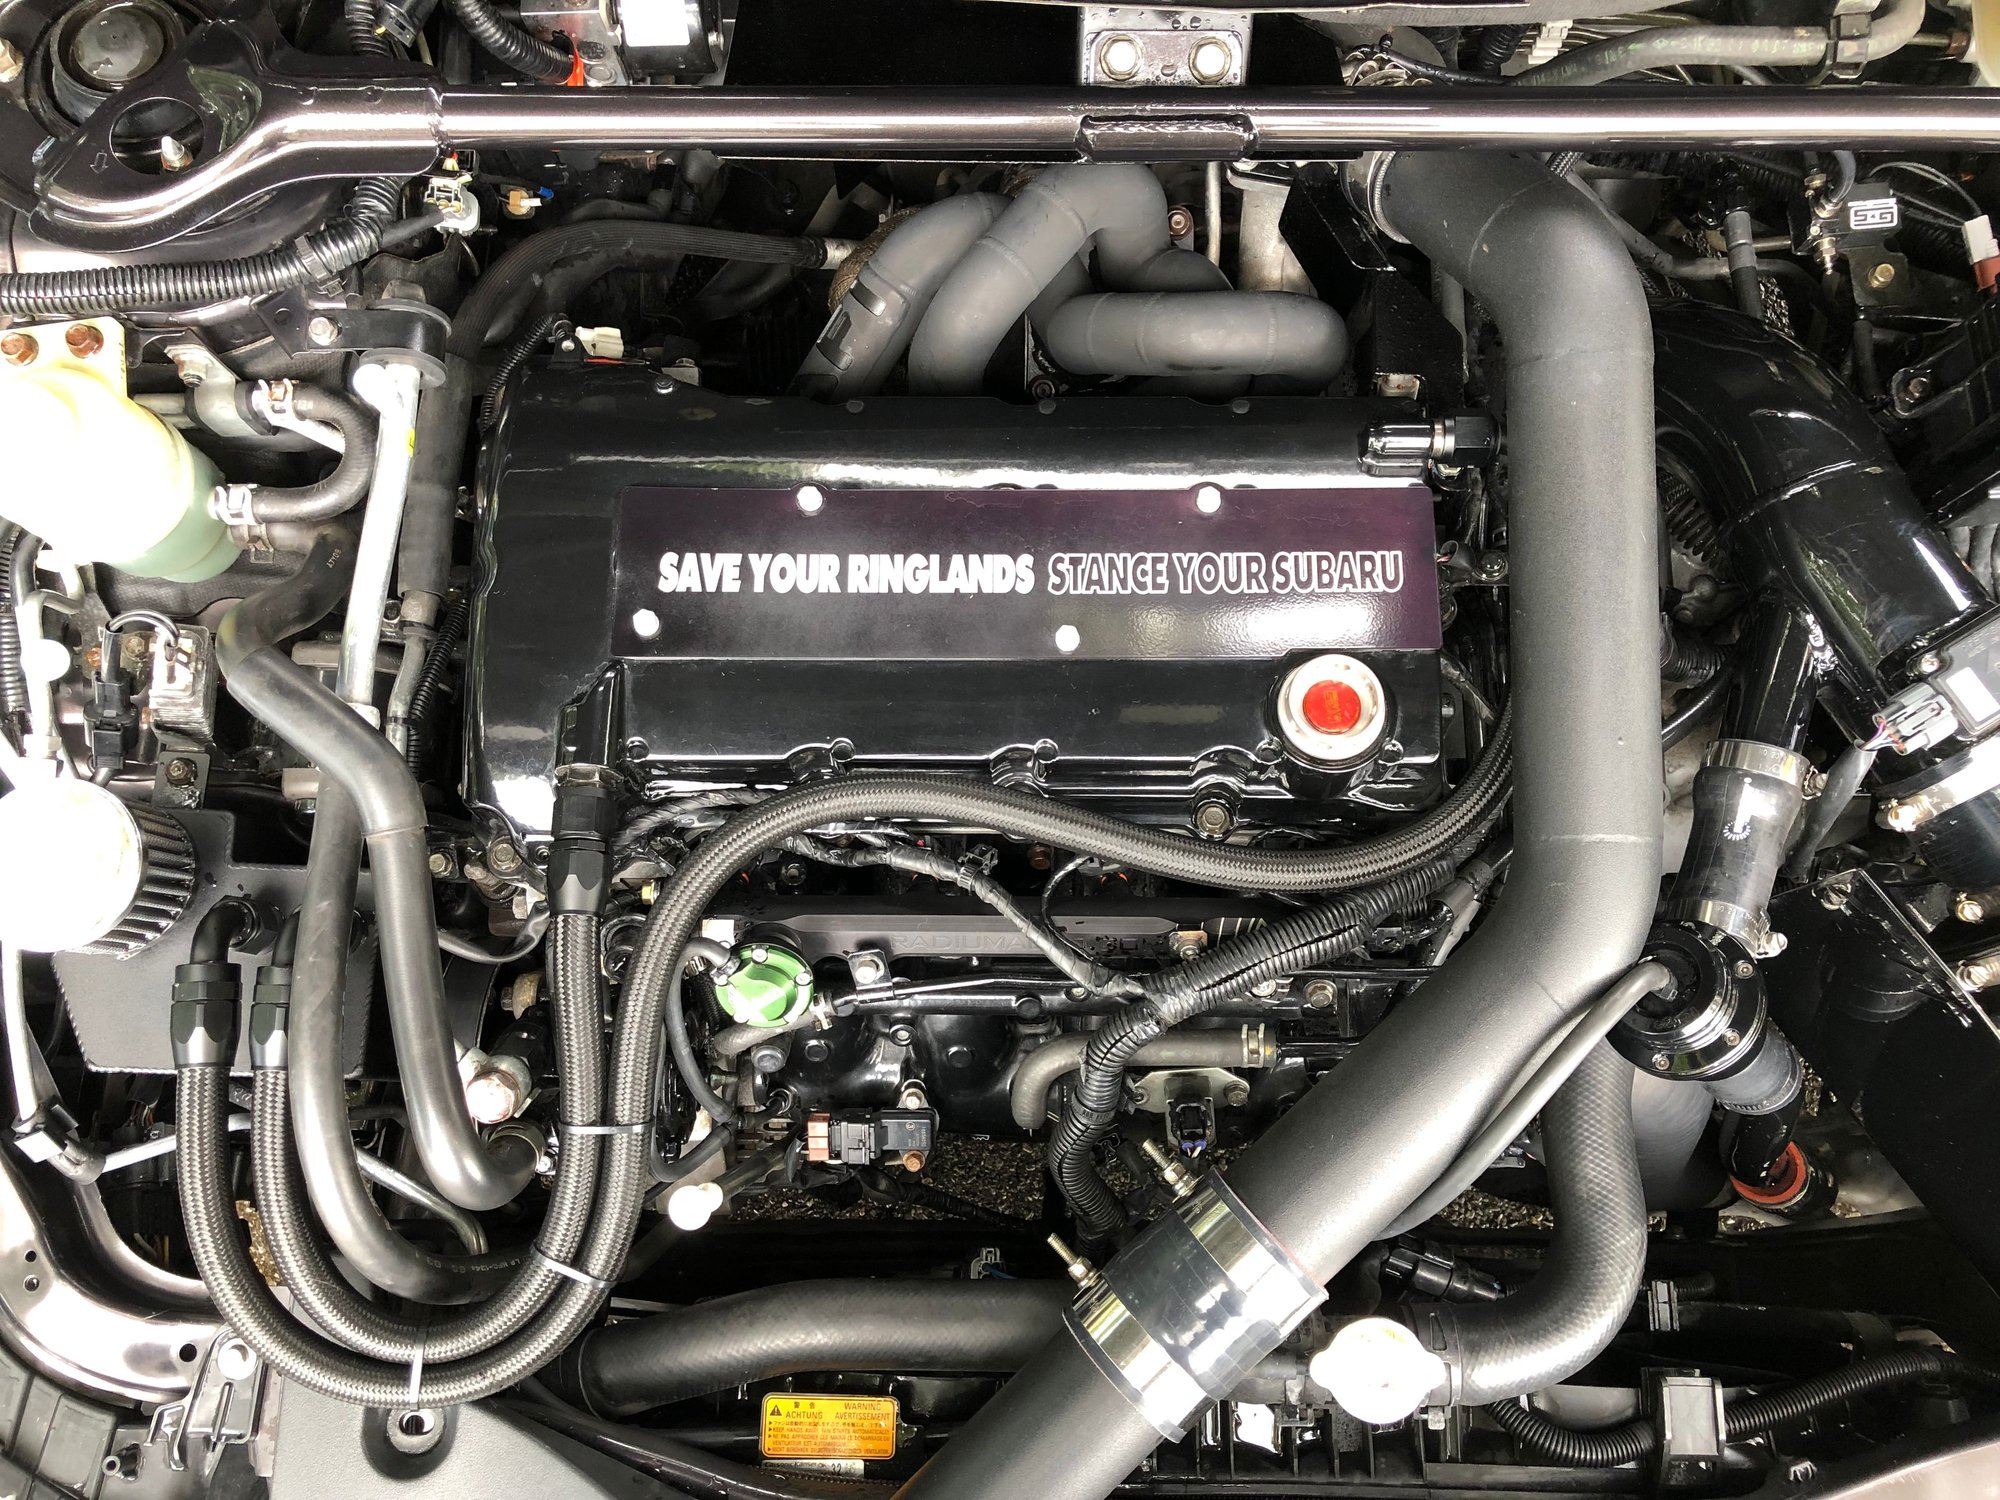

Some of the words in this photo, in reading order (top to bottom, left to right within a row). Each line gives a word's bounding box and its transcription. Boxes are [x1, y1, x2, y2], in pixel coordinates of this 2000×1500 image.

[657, 551, 743, 593] SAVE
[748, 553, 841, 594] YOUR
[848, 553, 1035, 594] RINGLANDS
[1048, 551, 1169, 595] STANCE
[1172, 551, 1269, 594] YOUR
[1272, 551, 1404, 593] SUBARU
[844, 1402, 882, 1410] WARNING
[786, 1411, 823, 1419] ACHTUNG
[834, 1412, 890, 1420] AVERTISSEMENT
